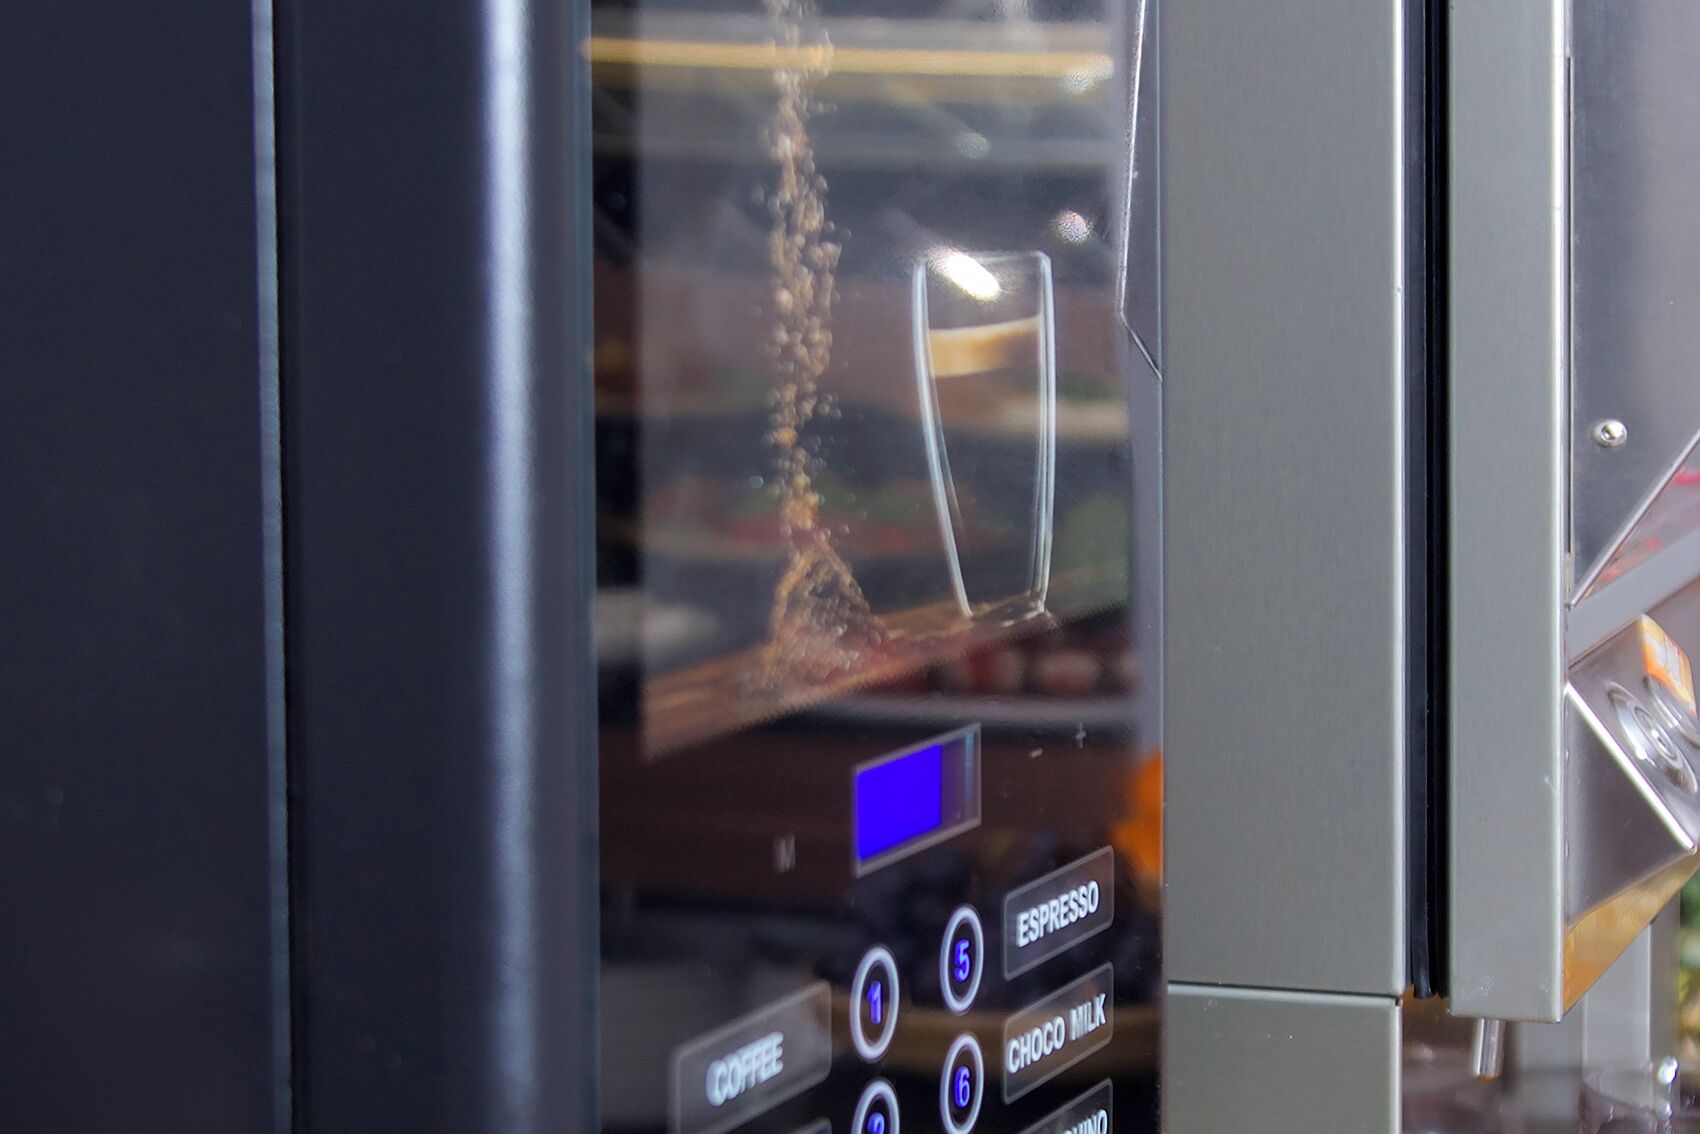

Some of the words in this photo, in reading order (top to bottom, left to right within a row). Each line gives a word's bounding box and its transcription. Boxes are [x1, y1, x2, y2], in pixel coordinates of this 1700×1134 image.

[1016, 880, 1099, 948] ESPRESSO
[954, 939, 970, 983] 5
[868, 981, 882, 1024] 1
[1007, 1016, 1066, 1075] CHOCO
[1069, 993, 1107, 1041] MILK
[706, 1032, 784, 1107] COFFEE
[955, 1066, 970, 1108] 6
